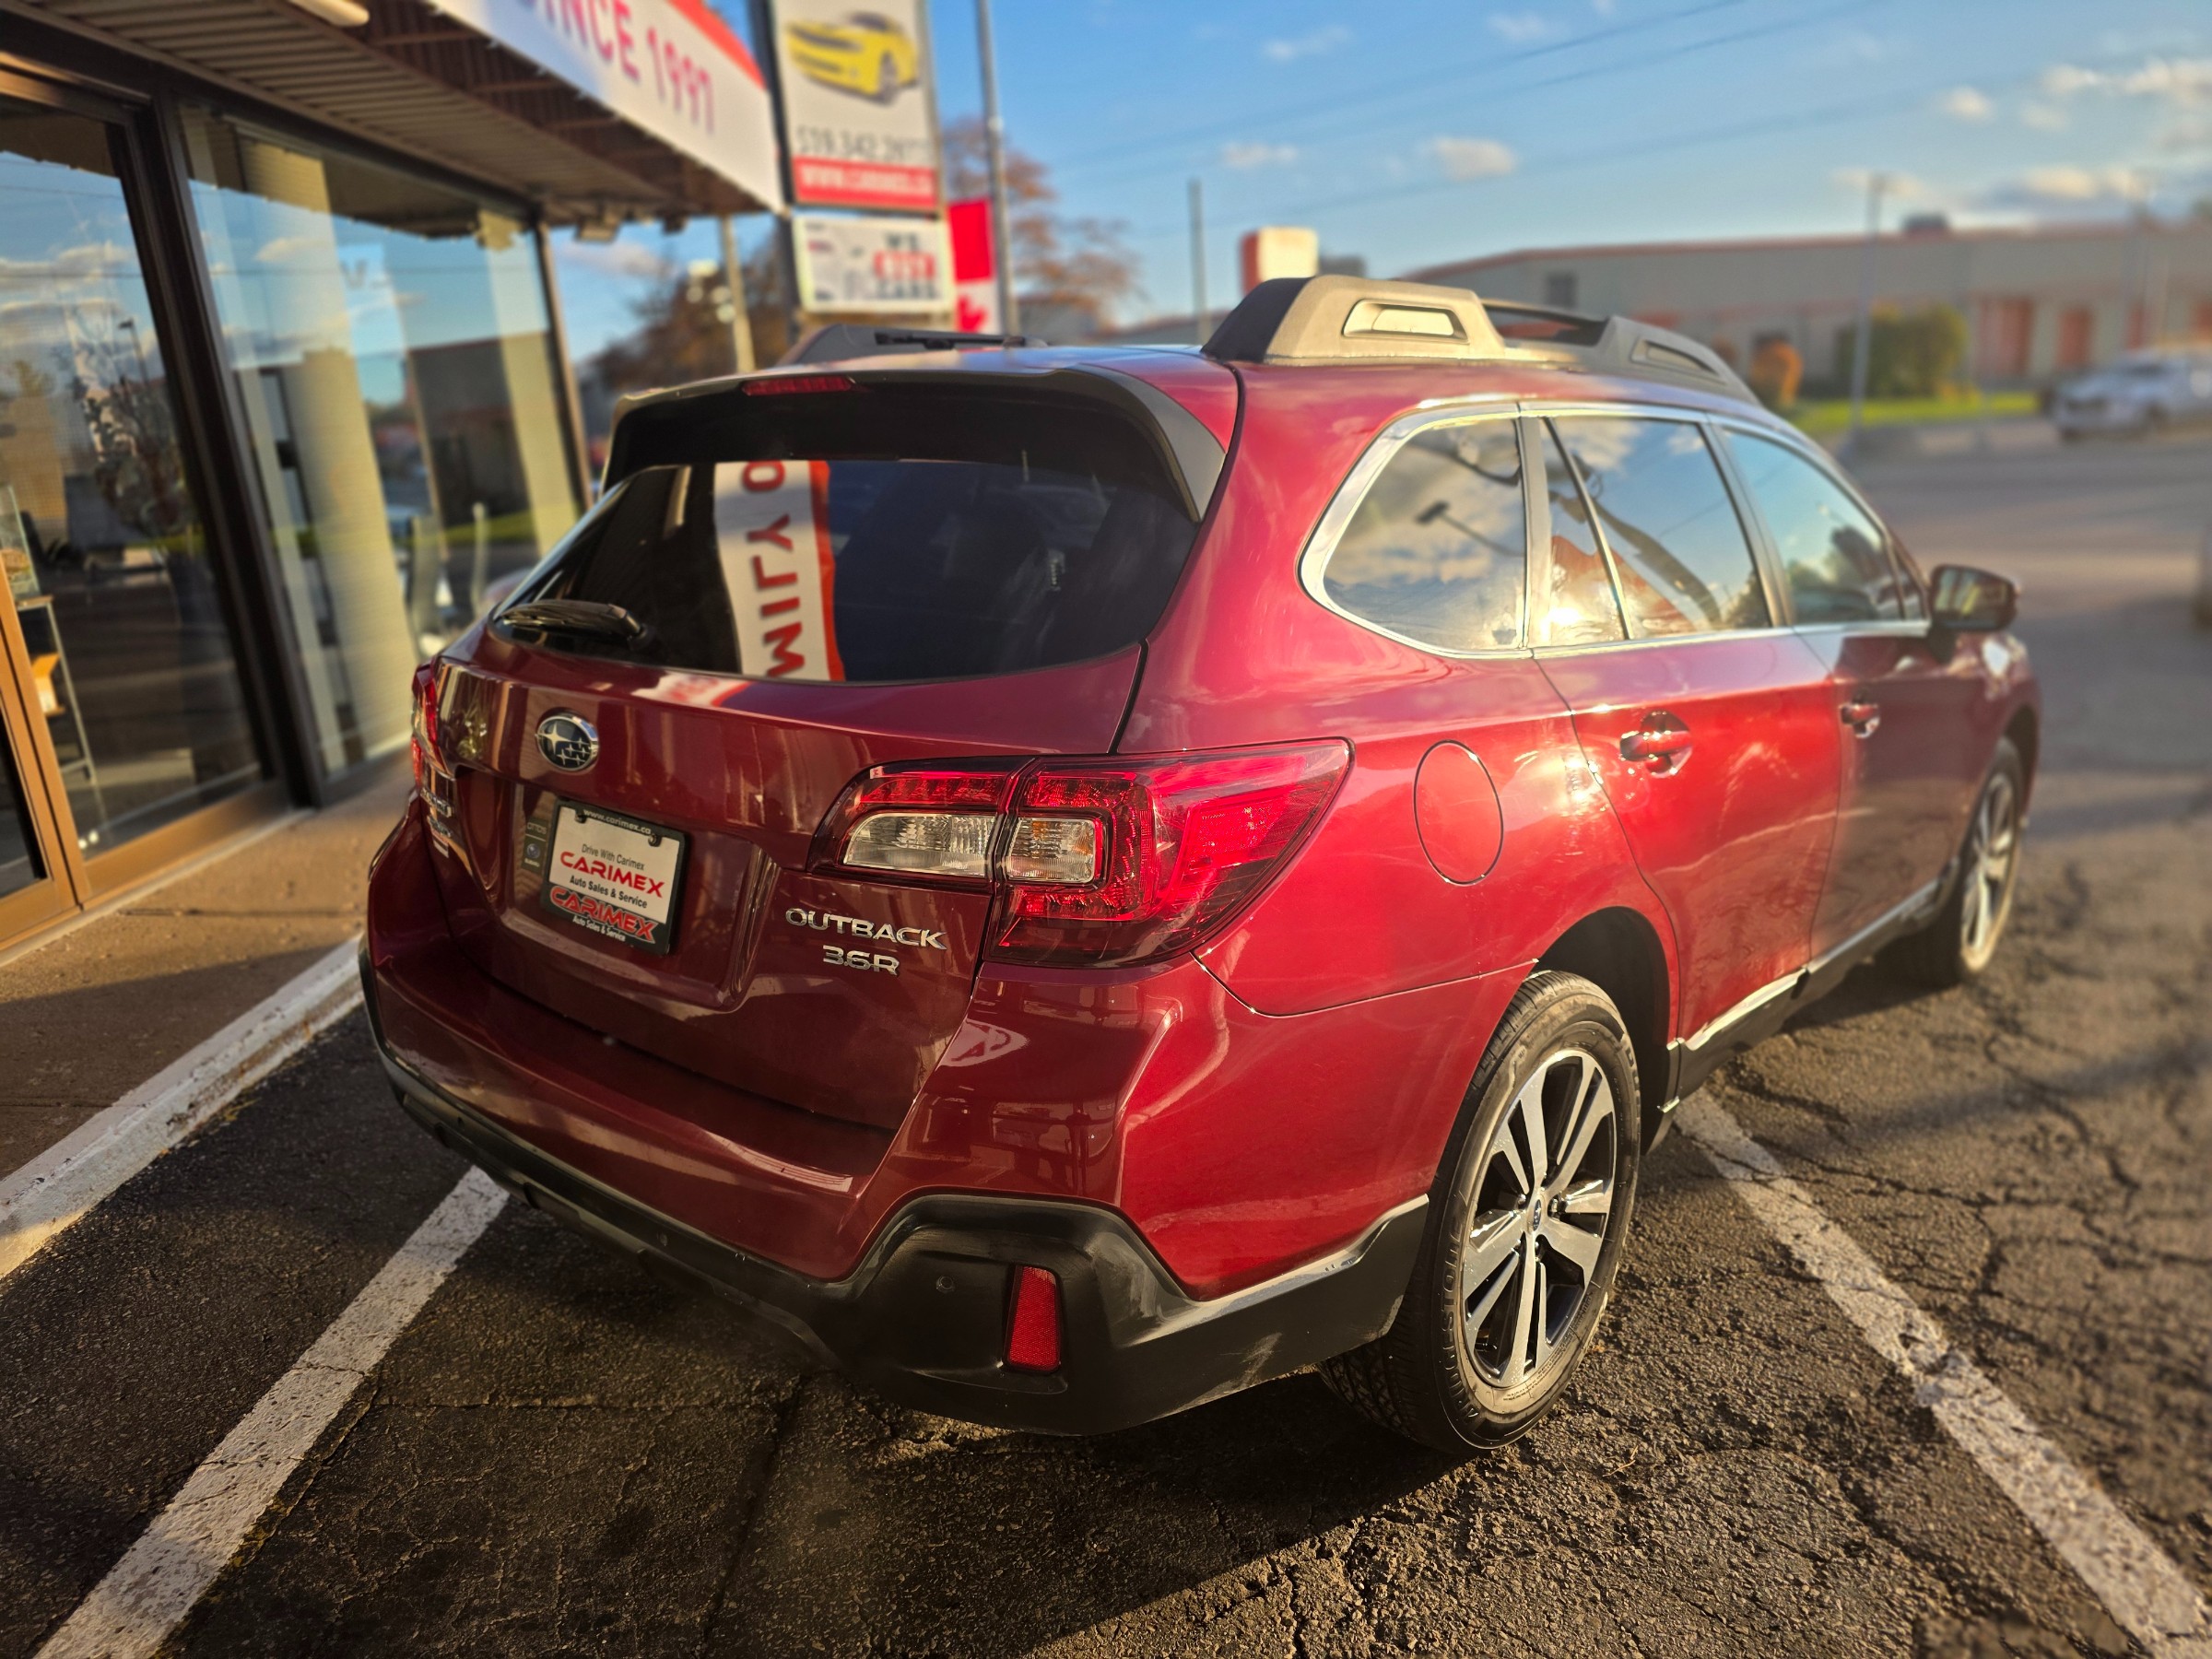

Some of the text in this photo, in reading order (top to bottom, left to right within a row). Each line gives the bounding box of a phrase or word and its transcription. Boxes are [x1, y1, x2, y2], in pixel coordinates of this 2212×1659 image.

[581, 843, 645, 871] Drive With Carimex
[559, 851, 665, 898] CARIMEX
[570, 875, 648, 909] Auto Sales & Service
[551, 887, 657, 943] CARIMEX
[572, 915, 586, 926] Auto
[586, 920, 600, 932] Sales
[606, 927, 626, 942] Service
[785, 908, 947, 950] OUTBACK
[823, 945, 900, 977] 3.6R
